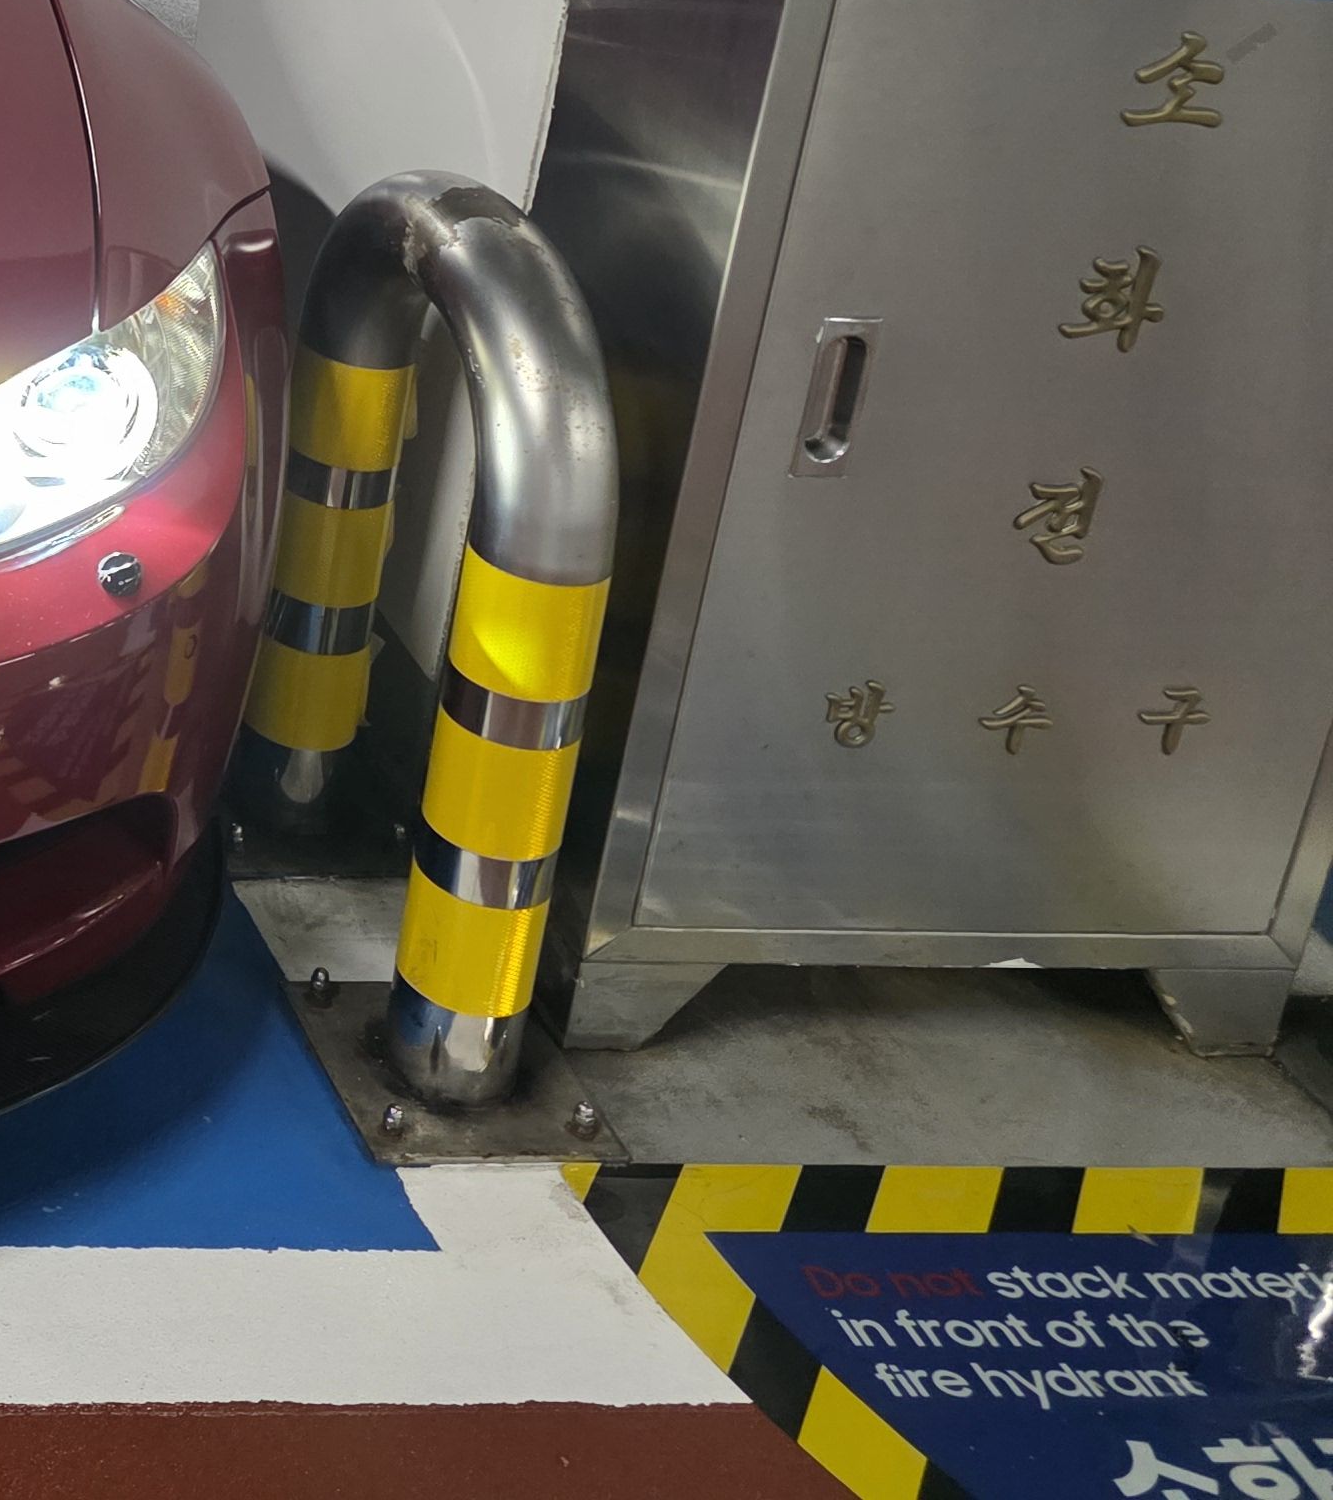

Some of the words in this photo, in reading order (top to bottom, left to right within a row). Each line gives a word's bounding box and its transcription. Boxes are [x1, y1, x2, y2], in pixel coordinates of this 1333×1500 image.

[825, 679, 1213, 756] 방수구
[800, 1264, 882, 1298] Do
[886, 1267, 983, 1298] not
[985, 1264, 1147, 1299] stack
[829, 1308, 897, 1348] in
[894, 1308, 1045, 1348] front
[1045, 1309, 1106, 1348] of
[1106, 1313, 1211, 1349] the
[874, 1362, 974, 1398] fire
[969, 1361, 1209, 1411] hydrant
